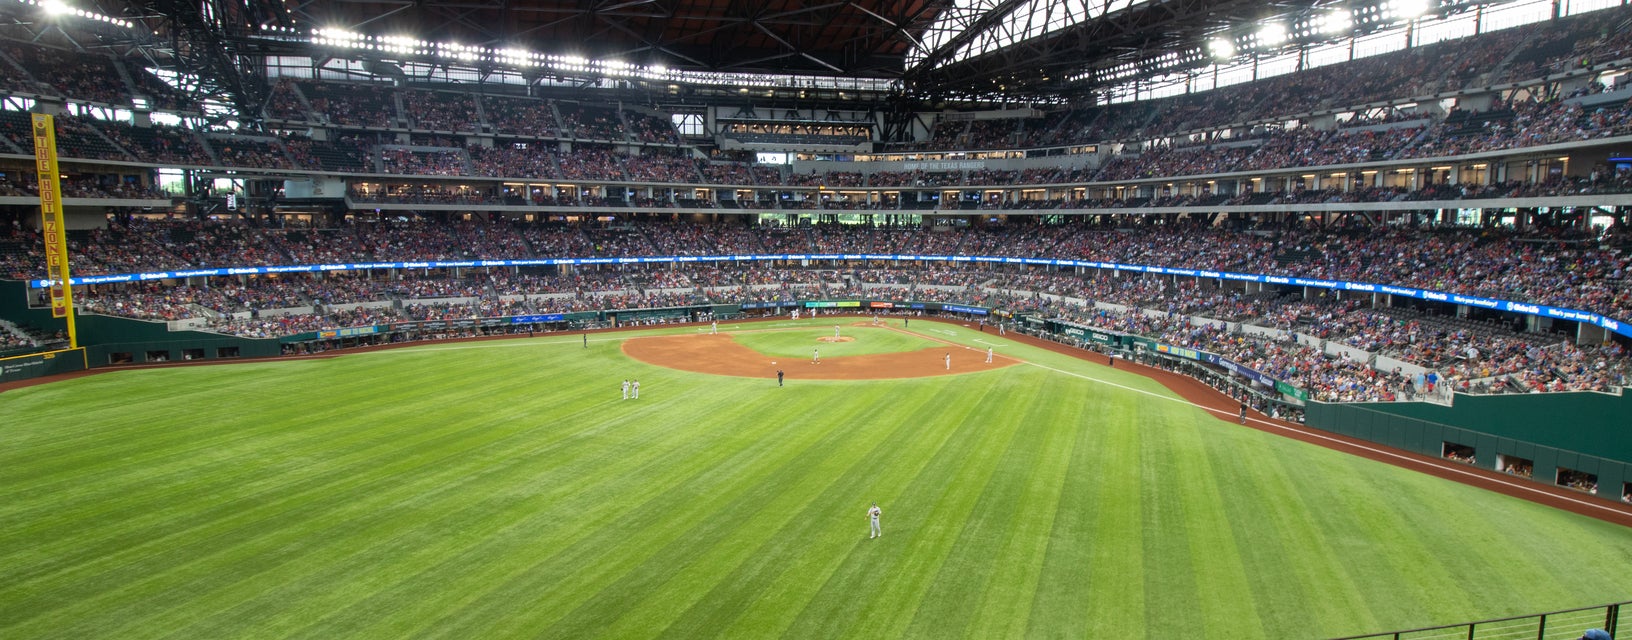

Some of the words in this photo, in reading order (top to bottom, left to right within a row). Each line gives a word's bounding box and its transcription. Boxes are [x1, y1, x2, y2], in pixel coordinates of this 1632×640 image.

[37, 137, 49, 170] THE
[904, 162, 919, 170] HOME
[921, 162, 928, 170] OF
[929, 162, 940, 170] THE
[960, 161, 984, 169] RANGERS
[43, 180, 53, 212] HOT
[47, 222, 59, 266] ZONE
[1514, 303, 1528, 311] Globe
[1528, 305, 1539, 314] Life
[1564, 311, 1576, 319] your
[1092, 333, 1109, 341] GEICO
